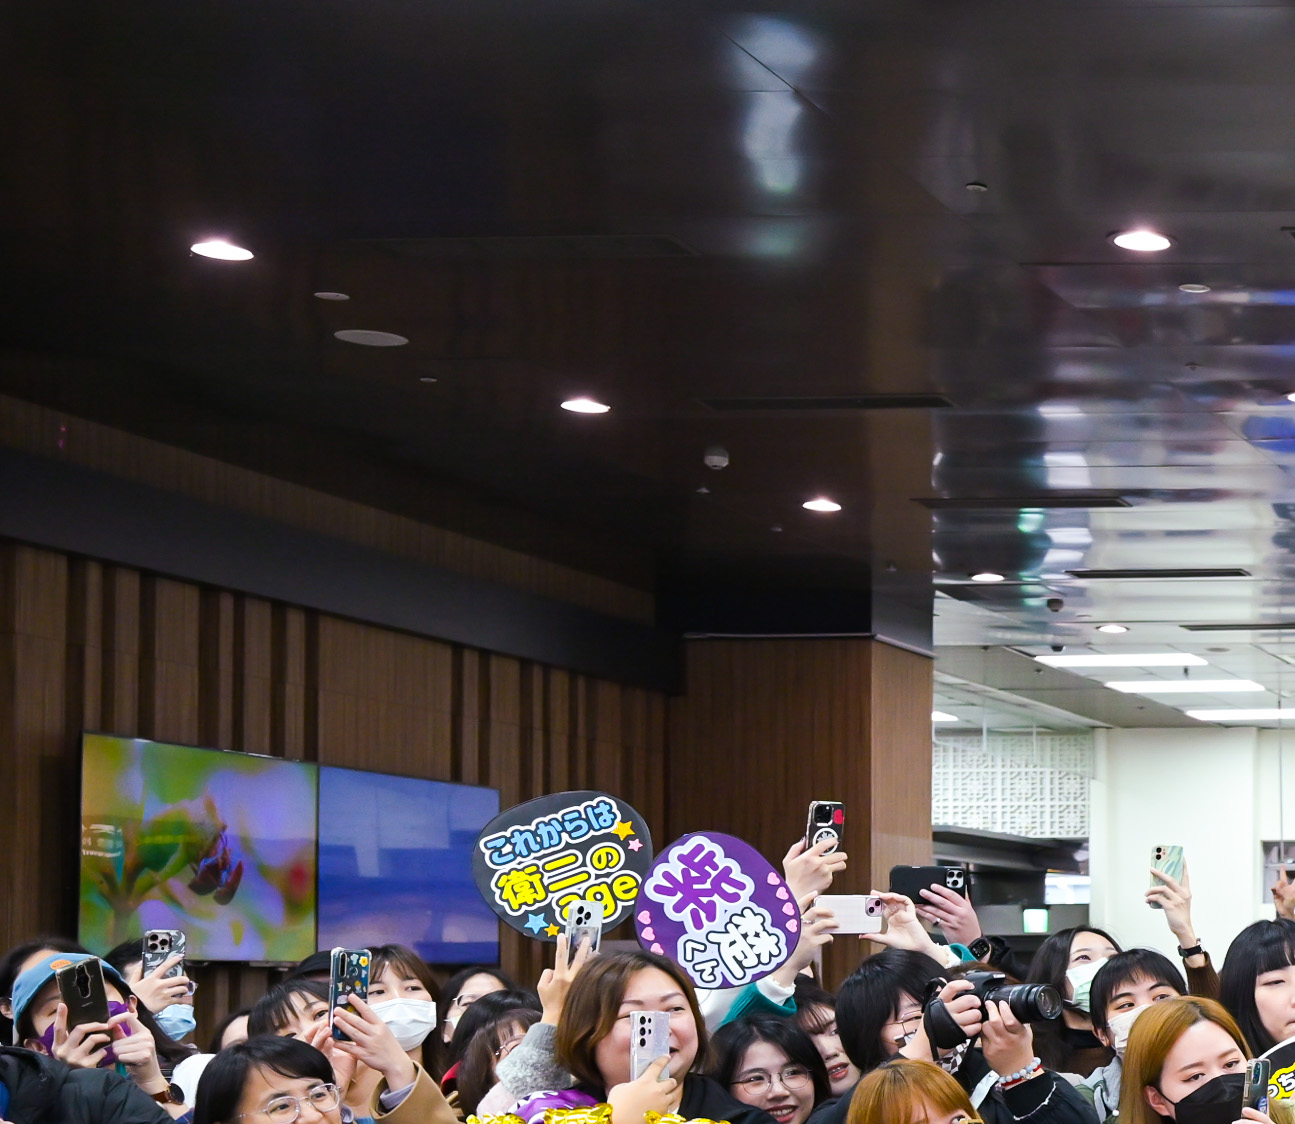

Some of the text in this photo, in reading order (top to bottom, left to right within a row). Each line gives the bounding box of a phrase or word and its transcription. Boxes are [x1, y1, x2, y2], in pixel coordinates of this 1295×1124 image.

[484, 800, 617, 865] これからは
[496, 846, 621, 911] 衛二の
